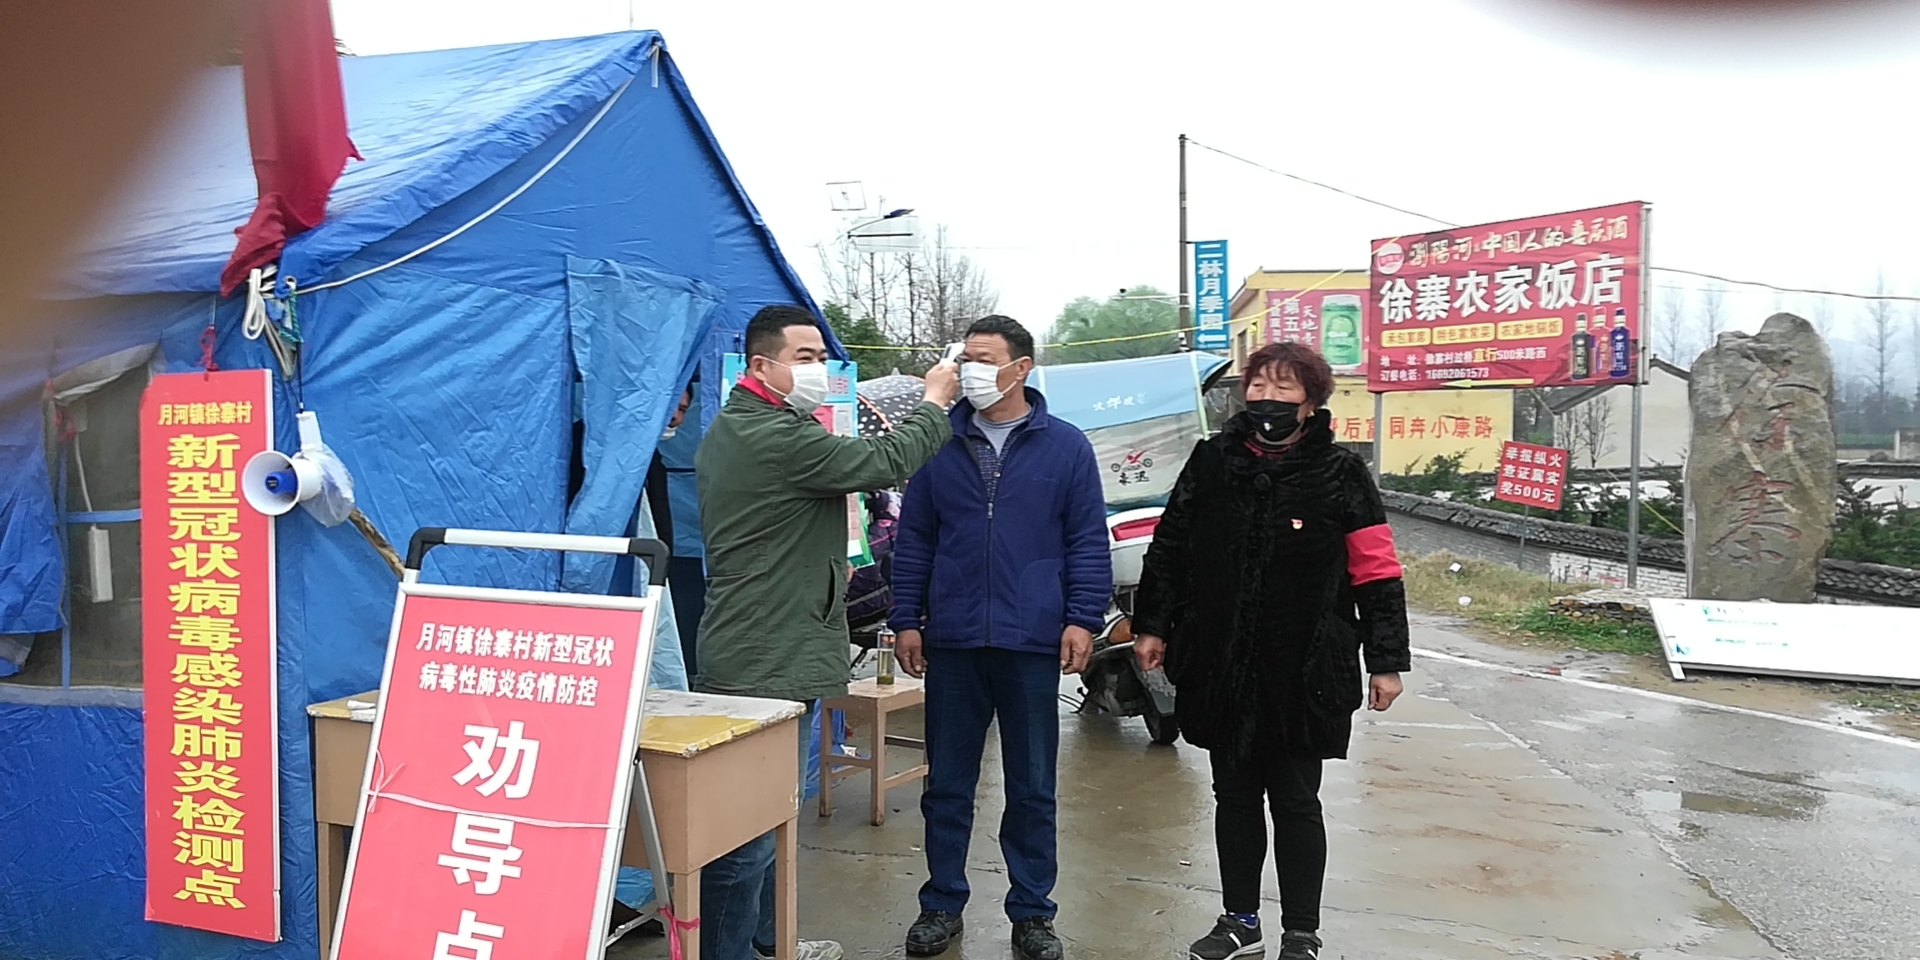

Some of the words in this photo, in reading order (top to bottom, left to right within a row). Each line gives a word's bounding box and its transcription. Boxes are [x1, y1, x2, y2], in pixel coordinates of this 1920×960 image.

[1379, 255, 1625, 324] 徐寨农家饭店
[157, 402, 253, 426] 月河镇徐寨村
[1505, 446, 1562, 468] 举报纵火
[1500, 480, 1556, 503] 奖500元
[1502, 464, 1560, 486] 查证属实
[168, 432, 246, 909] 新型冠状病毒感染肺炎检测点
[419, 661, 599, 707] 病毒性肺炎疫情防控
[433, 720, 540, 960] 劝导点
